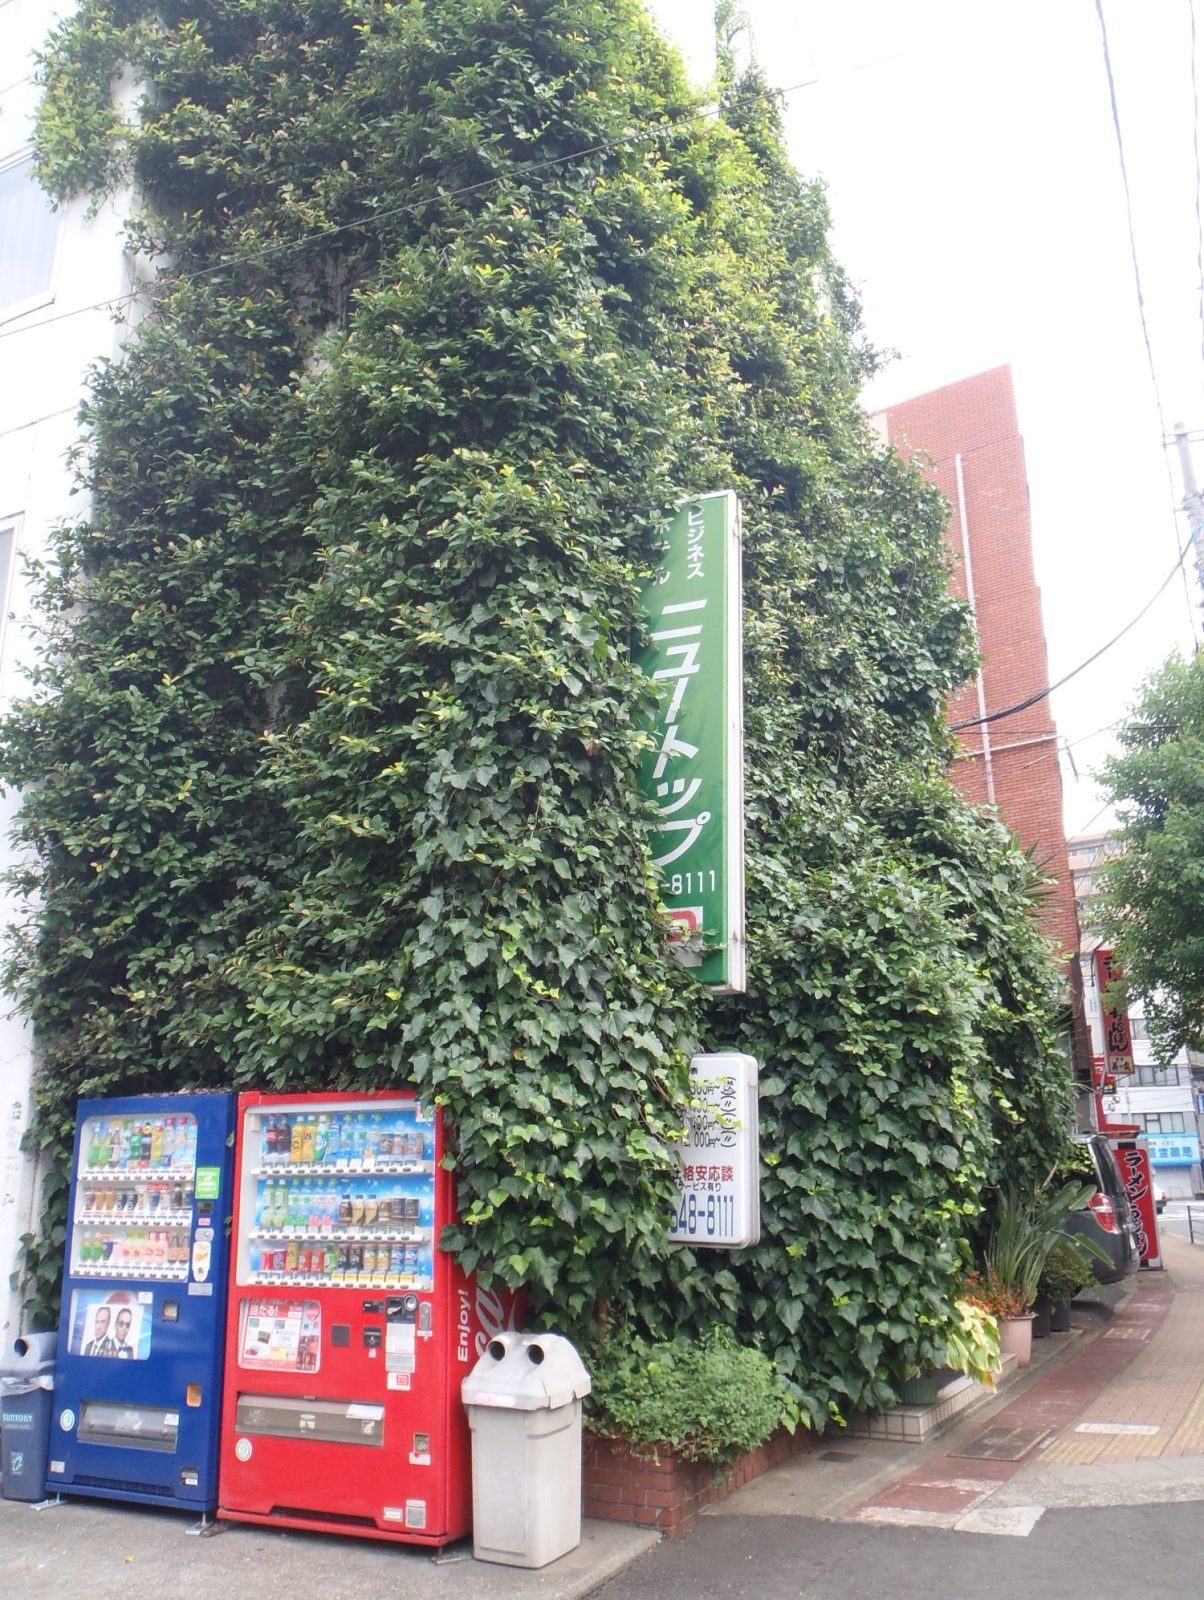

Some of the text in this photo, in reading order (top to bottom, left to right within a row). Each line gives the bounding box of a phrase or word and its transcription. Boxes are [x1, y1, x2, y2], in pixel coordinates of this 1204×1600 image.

[687, 509, 705, 580] ビジネス
[650, 598, 711, 867] ニュートップ
[683, 1164, 734, 1182] 格安応談
[1124, 1150, 1149, 1203] ラーメン
[457, 1288, 471, 1362] Enjoy!
[2, 1413, 33, 1423] SUNTORY
